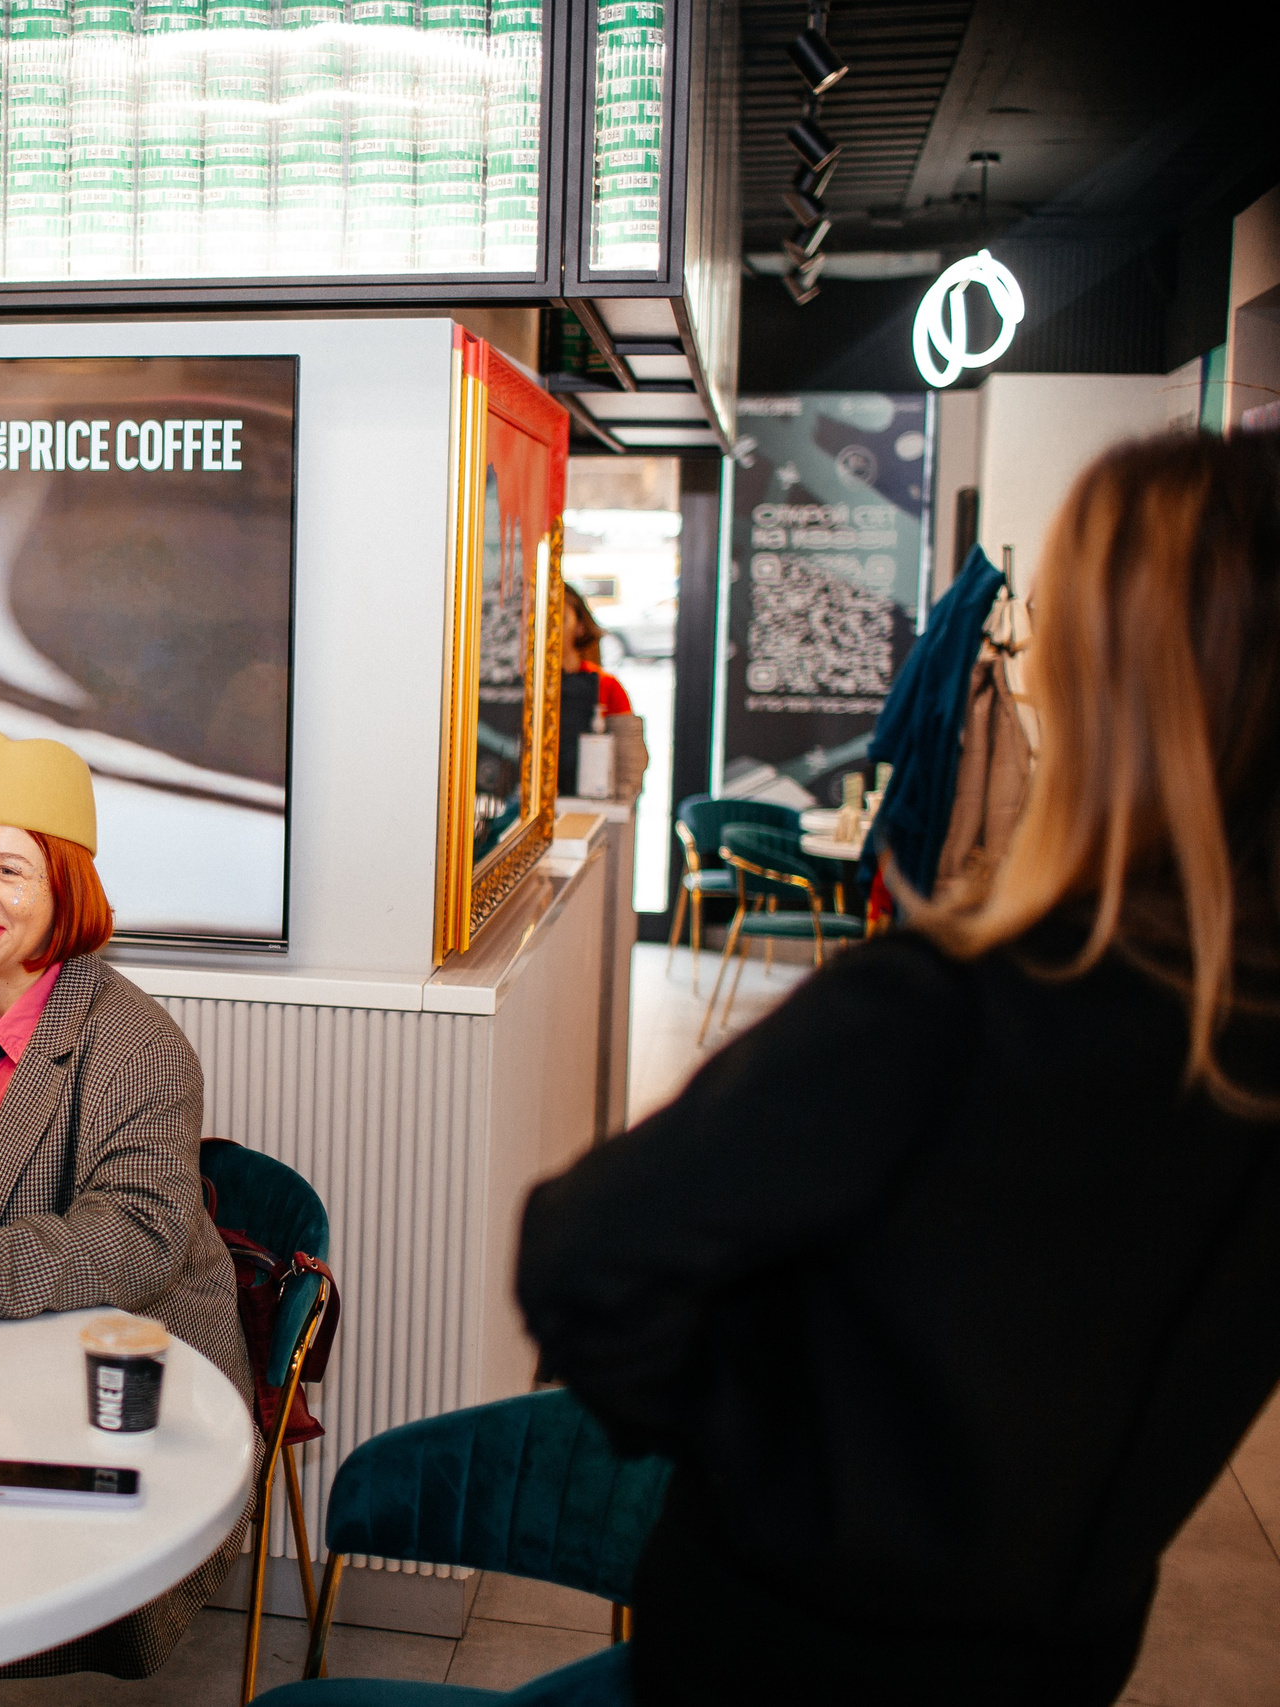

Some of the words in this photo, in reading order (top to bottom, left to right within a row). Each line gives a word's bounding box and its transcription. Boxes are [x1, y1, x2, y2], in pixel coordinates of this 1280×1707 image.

[8, 420, 110, 471] PRICE
[116, 420, 243, 471] COFFEE
[98, 1388, 123, 1430] ONE
